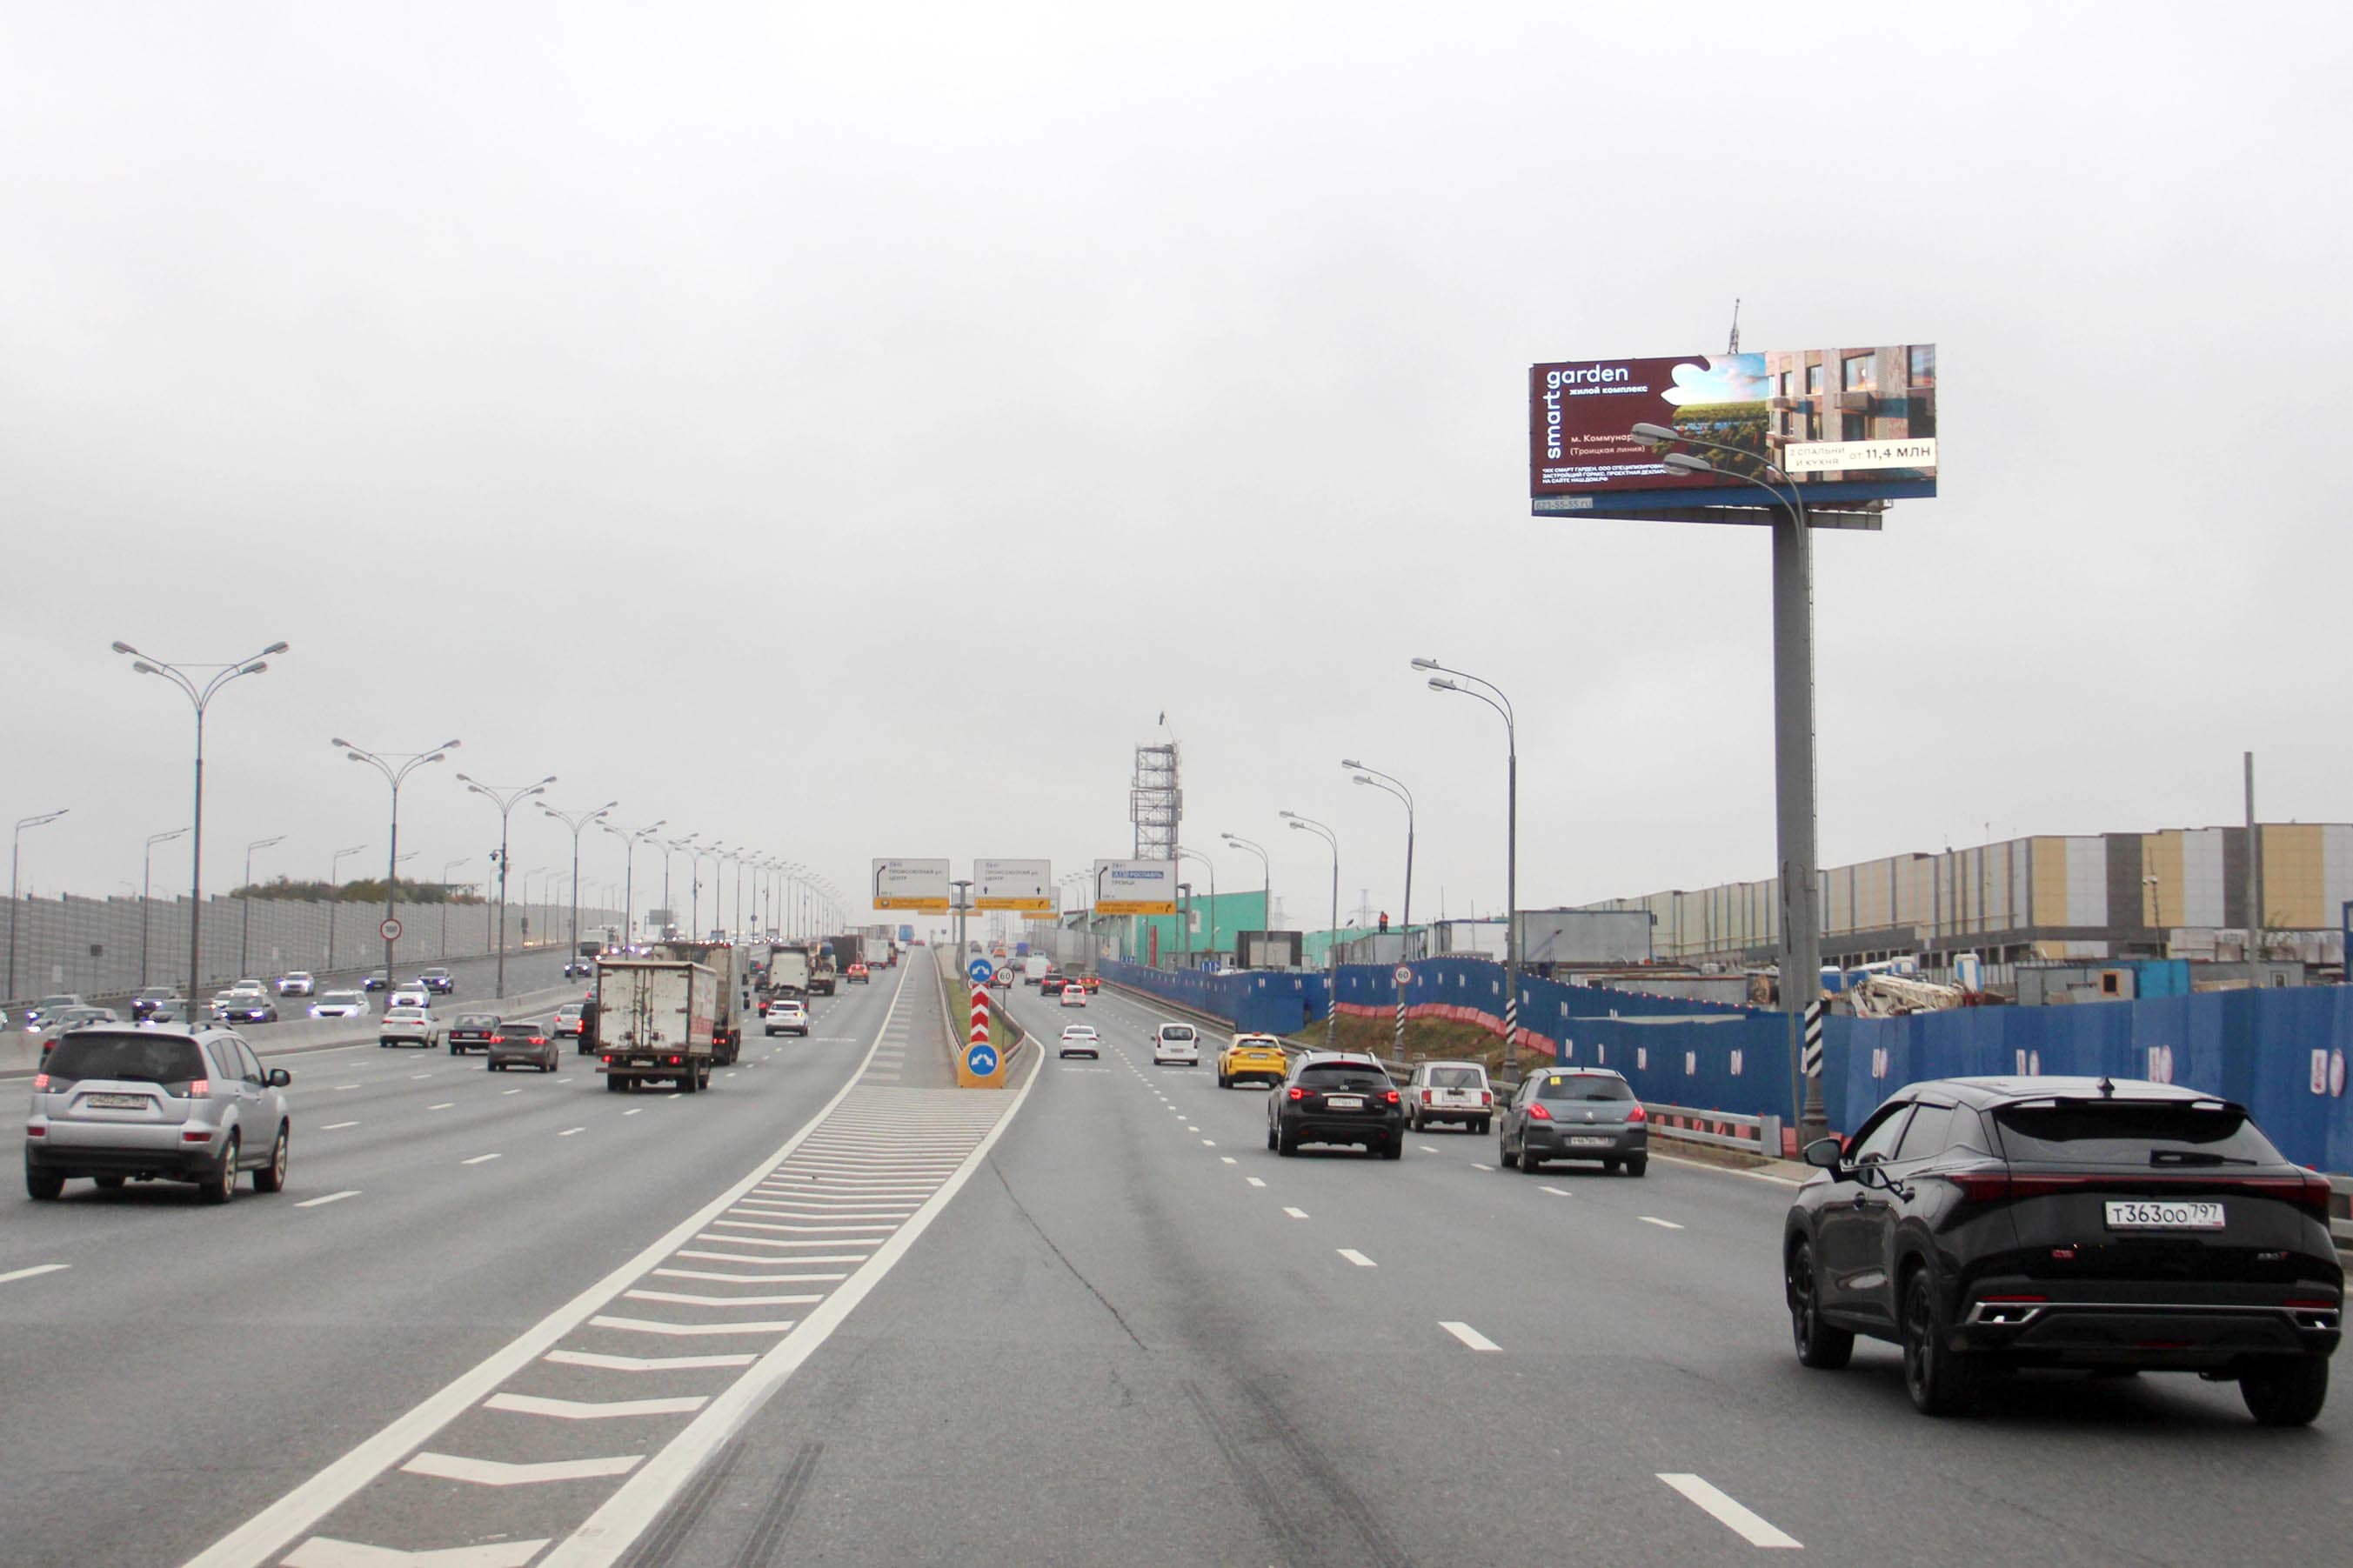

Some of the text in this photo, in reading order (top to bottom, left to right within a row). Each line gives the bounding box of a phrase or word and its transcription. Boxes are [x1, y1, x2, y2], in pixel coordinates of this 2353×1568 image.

[1547, 364, 1628, 390] garden
[1569, 385, 1648, 396] жилой комплекс
[1543, 390, 1561, 459] smart
[1583, 434, 1633, 444] Коммунар
[1570, 445, 1646, 457] (Троицкая линия)
[1797, 447, 1845, 457] СПАЛЬНИ
[1866, 448, 1892, 460] 11,4
[1896, 446, 1930, 457] МЛН
[999, 971, 1011, 980] 60
[1397, 971, 1409, 980] 60
[2190, 1204, 2217, 1218] 797
